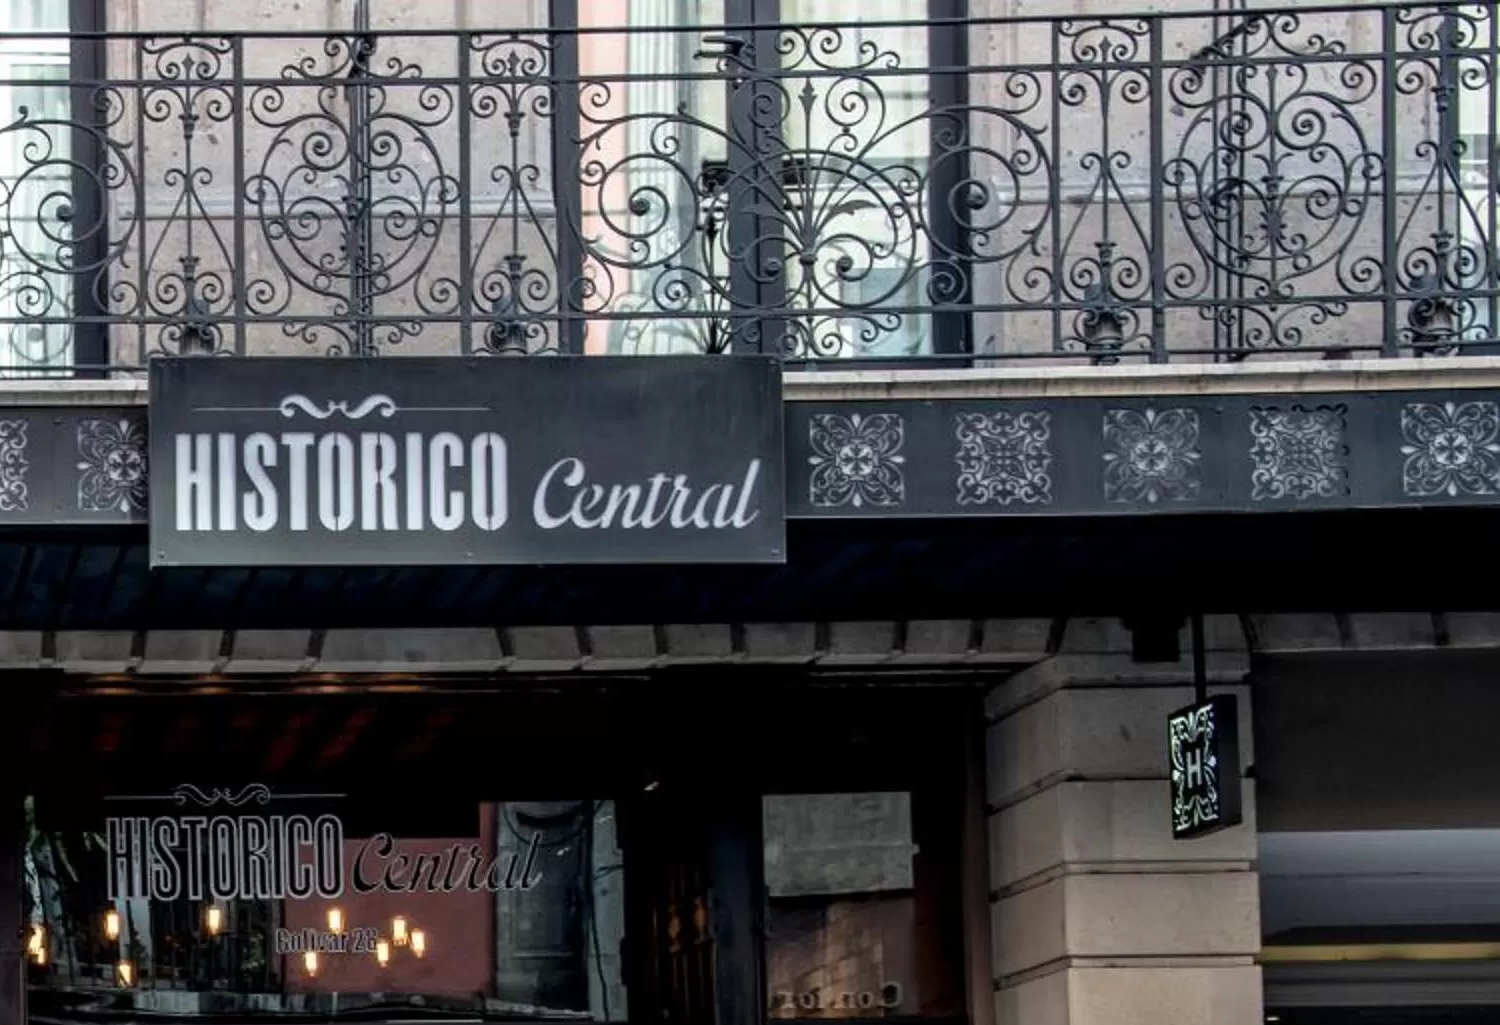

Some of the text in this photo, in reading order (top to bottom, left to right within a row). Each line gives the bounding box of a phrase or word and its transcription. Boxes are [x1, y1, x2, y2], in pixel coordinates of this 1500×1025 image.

[175, 431, 762, 531] HISTORICO Central
[106, 814, 544, 901] HISTORICO Central
